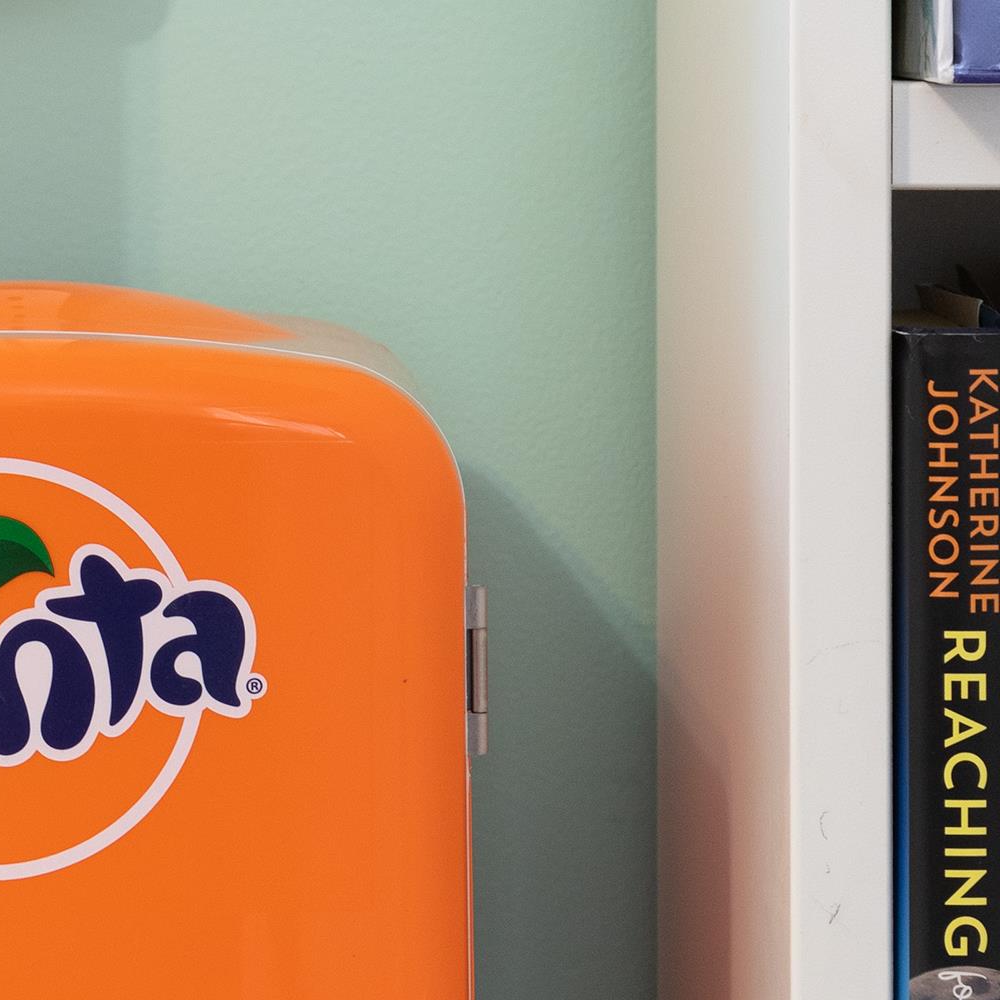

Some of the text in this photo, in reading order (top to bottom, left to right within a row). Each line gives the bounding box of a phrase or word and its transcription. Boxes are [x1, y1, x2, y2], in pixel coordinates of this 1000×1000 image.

[927, 379, 960, 598] JOHNSON
[969, 369, 1000, 613] KATHERINE
[944, 630, 988, 956] REACHING
